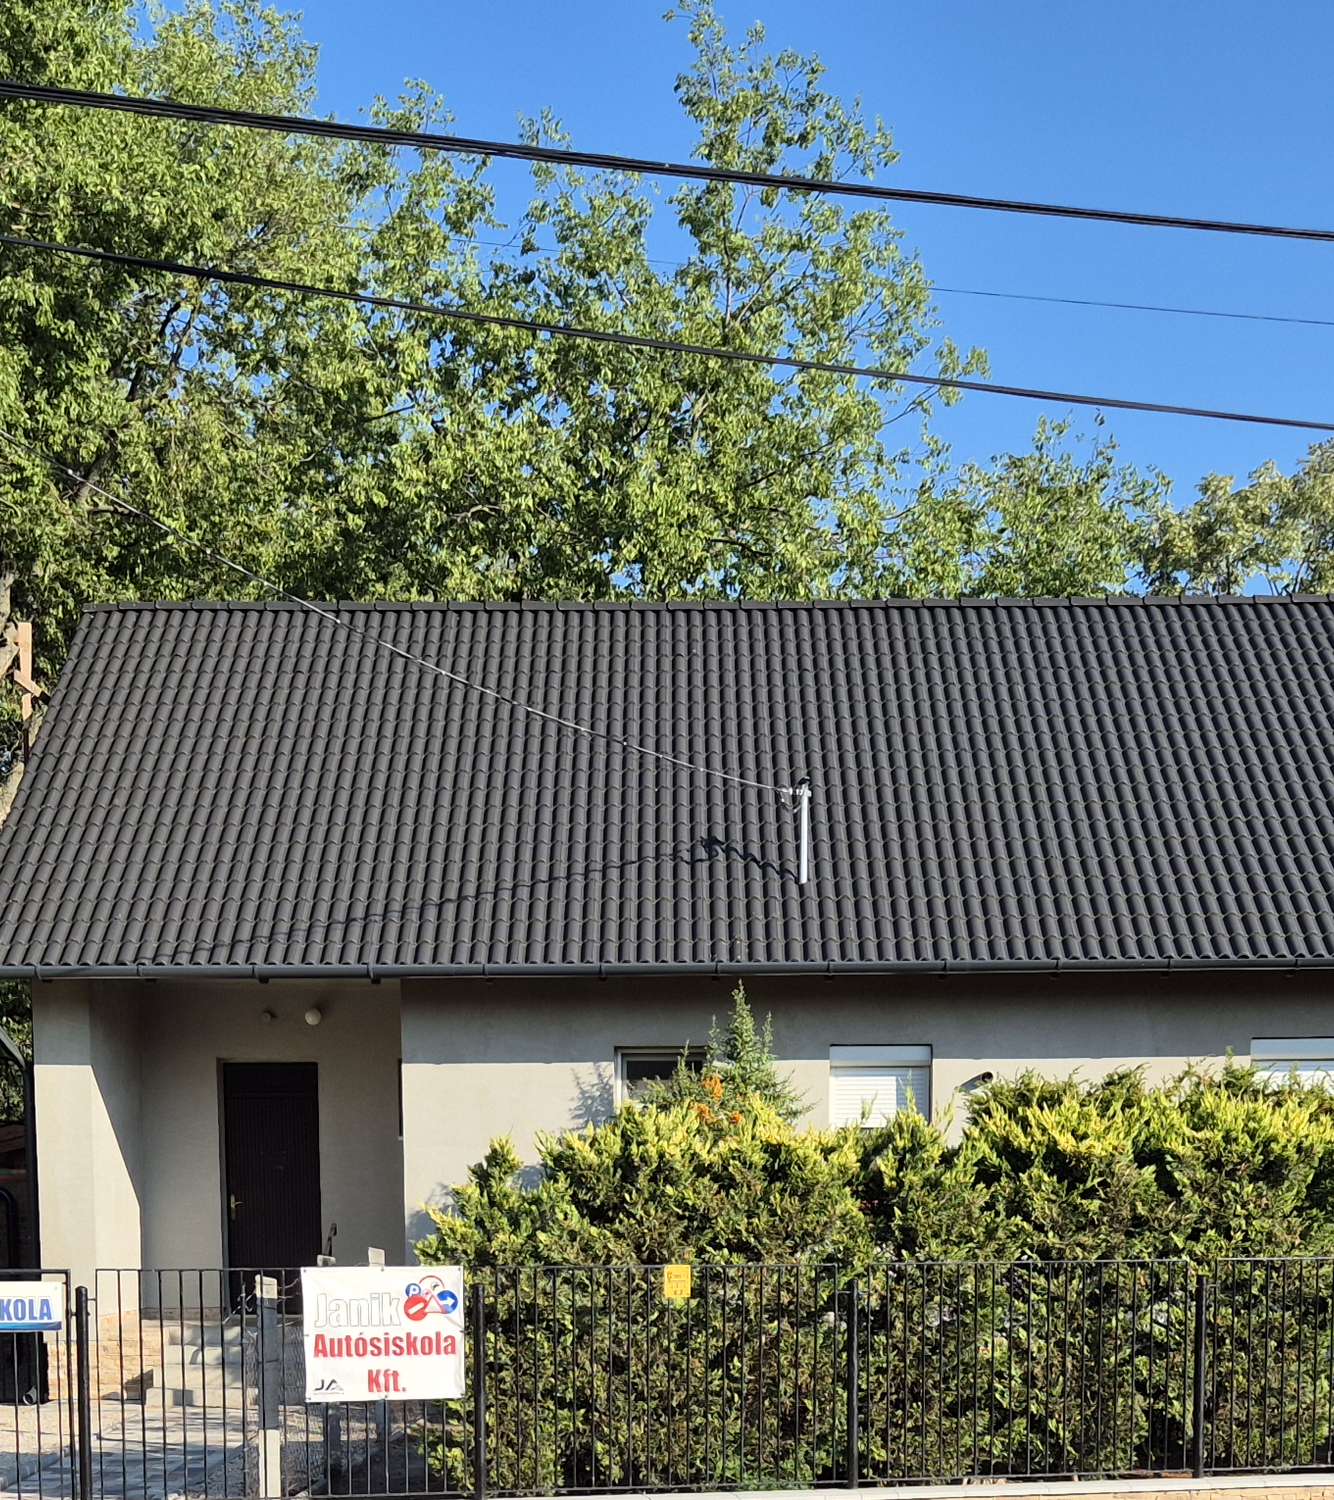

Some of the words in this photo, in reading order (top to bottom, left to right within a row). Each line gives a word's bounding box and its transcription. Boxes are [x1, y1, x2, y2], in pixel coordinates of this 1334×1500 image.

[313, 1292, 402, 1328] Janik
[313, 1331, 457, 1358] Autósiskola
[367, 1368, 407, 1393] Kft.
